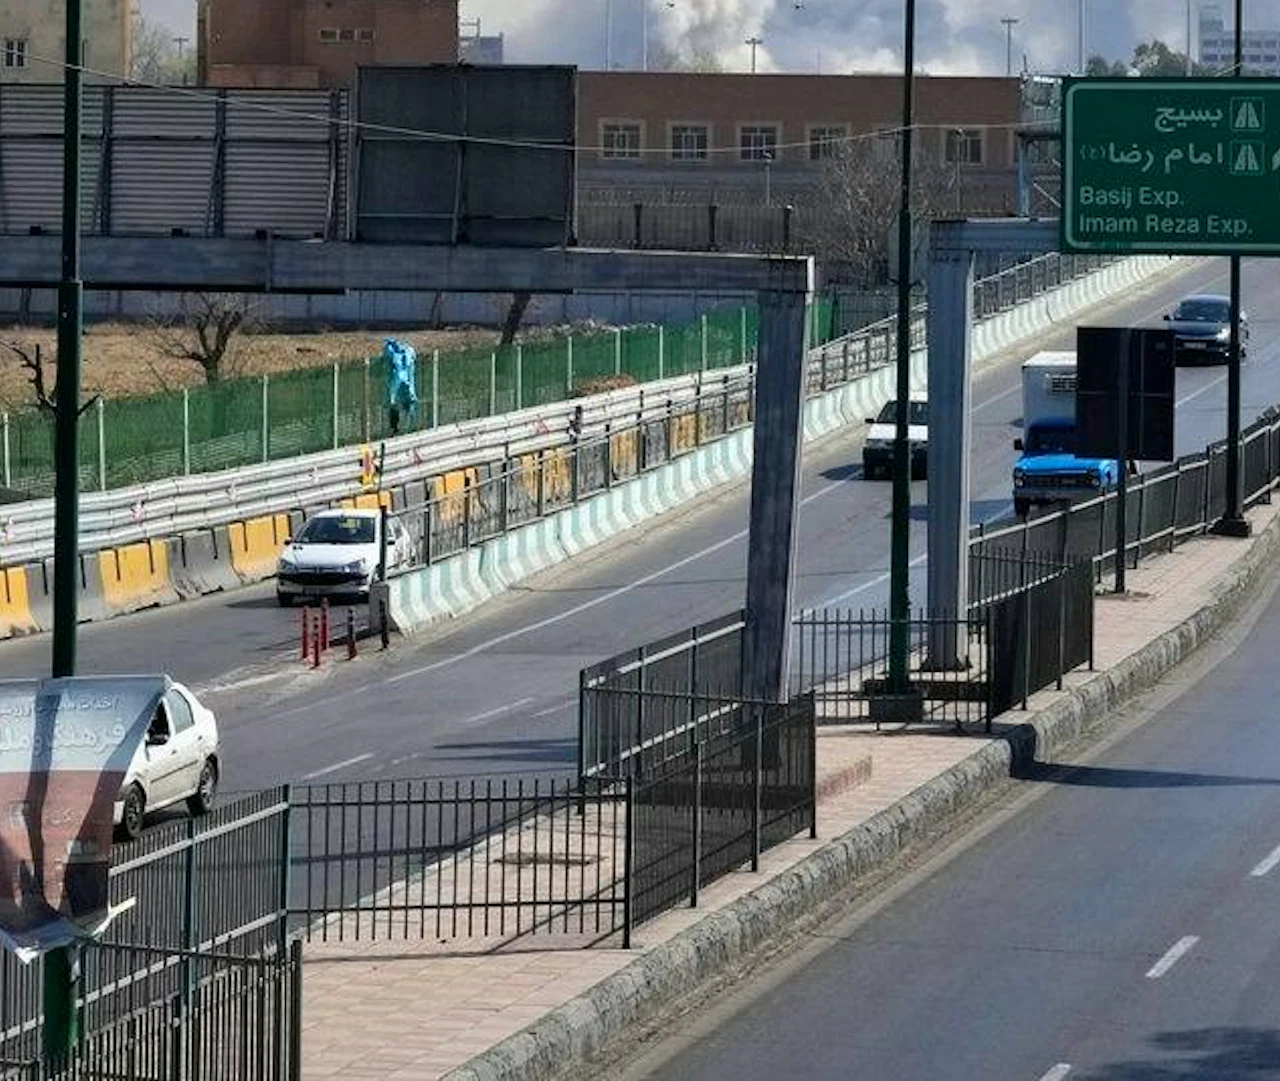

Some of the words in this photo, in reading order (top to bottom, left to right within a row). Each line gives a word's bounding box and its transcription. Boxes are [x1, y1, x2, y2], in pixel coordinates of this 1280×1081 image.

[1154, 107, 1224, 133] بسیج
[1164, 142, 1225, 173] امام
[1079, 186, 1133, 209] Basij
[1138, 187, 1185, 209] Exp.
[1079, 215, 1138, 234] Imam
[1146, 215, 1201, 235] Reza
[1206, 217, 1253, 237] Exp.
